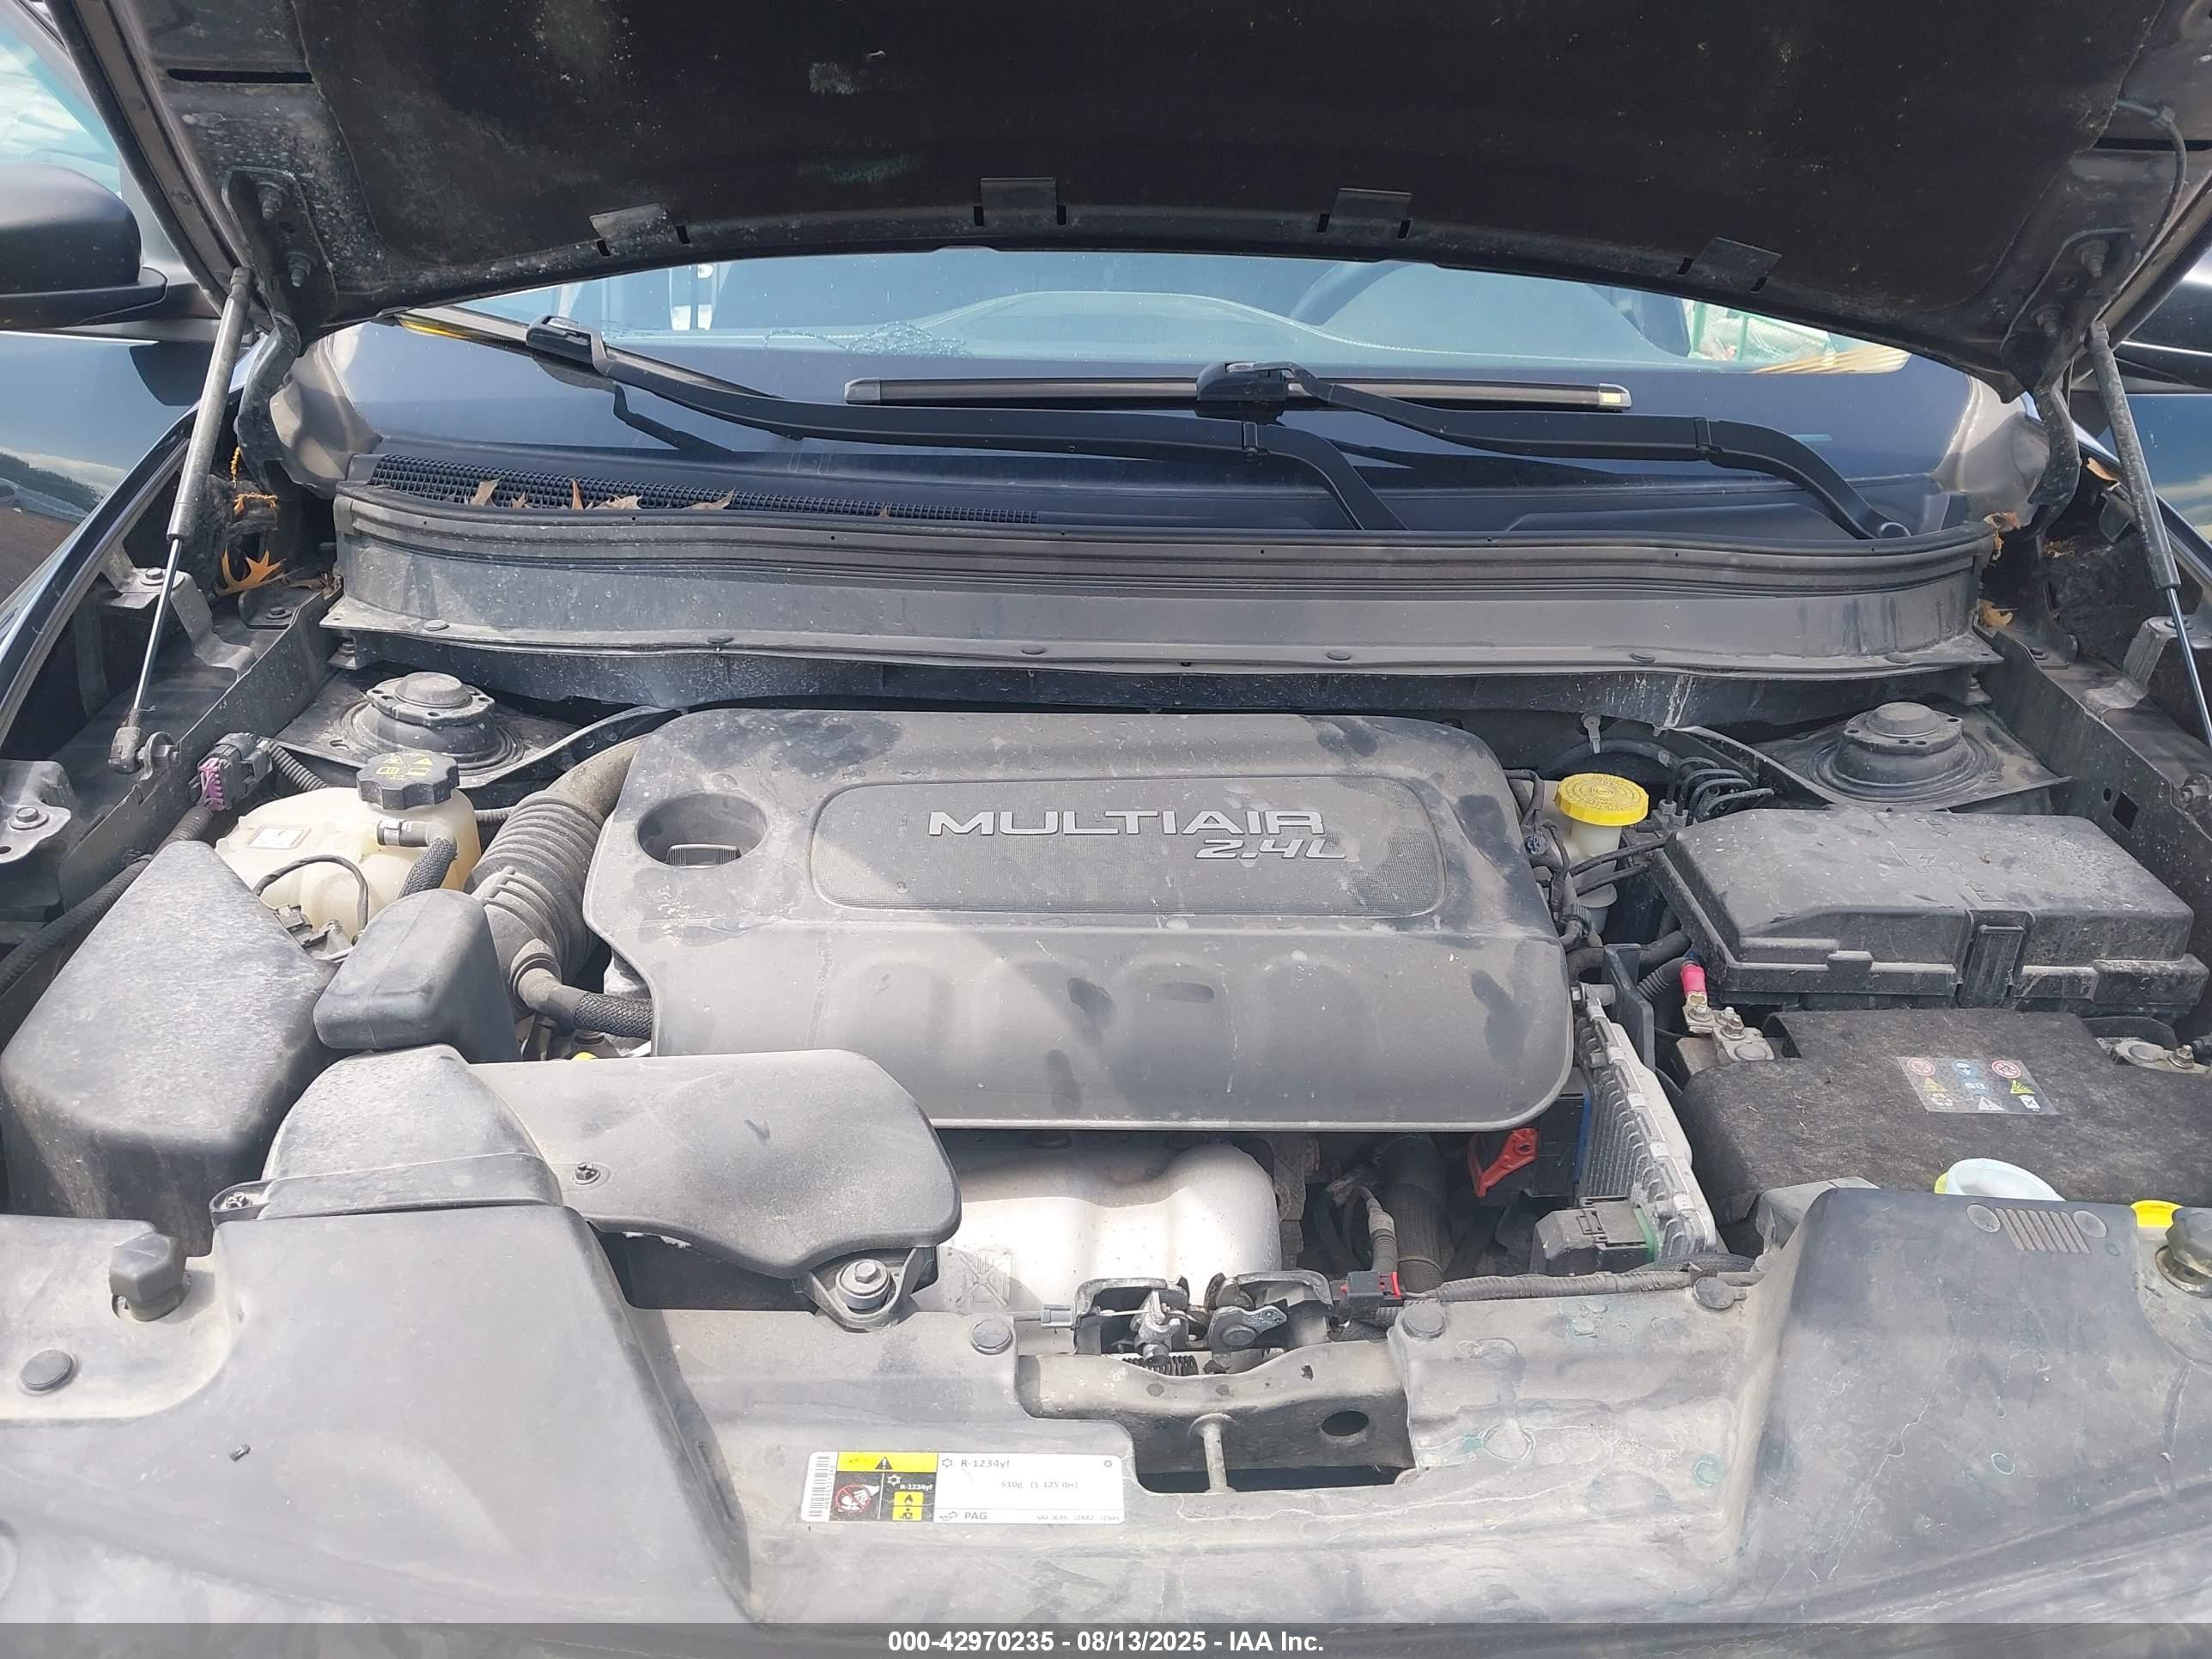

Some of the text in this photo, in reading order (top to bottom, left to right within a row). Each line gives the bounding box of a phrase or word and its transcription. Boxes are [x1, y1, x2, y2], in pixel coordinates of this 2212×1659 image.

[928, 811, 1325, 836] MULTIAIR
[1195, 838, 1347, 860] 2.4L
[961, 1459, 1010, 1469] R-1234yf
[1030, 1481, 1059, 1490] (1125
[964, 1511, 988, 1520] PAG
